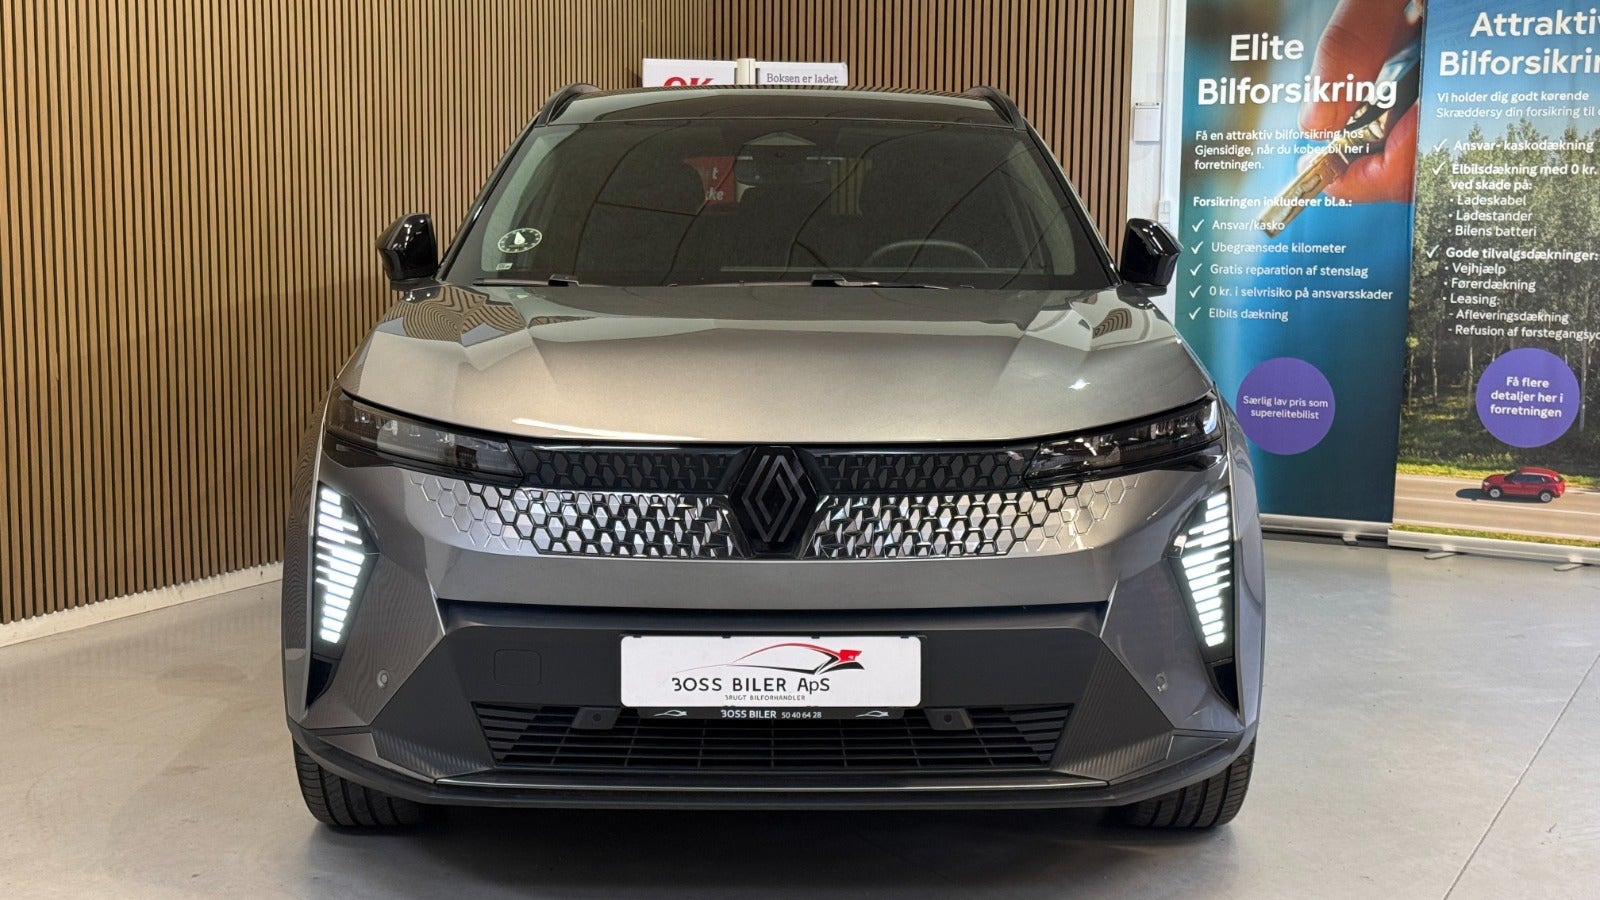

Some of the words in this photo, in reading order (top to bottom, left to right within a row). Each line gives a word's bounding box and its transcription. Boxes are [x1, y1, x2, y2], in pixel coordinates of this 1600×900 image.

[1470, 8, 1600, 37] Attrakti
[1230, 32, 1304, 61] Elite
[767, 73, 800, 84] Boksen
[802, 75, 812, 83] er
[814, 74, 838, 84] ladet
[1198, 74, 1398, 109] Bilforsikring
[1437, 92, 1449, 102] Vi
[1451, 92, 1488, 102] holder
[1490, 91, 1508, 104] dig
[1511, 91, 1538, 104] godt
[1541, 90, 1590, 101] kørende
[1436, 107, 1502, 119] Skræddersy
[1505, 106, 1522, 117] din
[1526, 106, 1580, 119] forsikring
[1583, 106, 1594, 117] til
[1196, 130, 1208, 140] Få
[1210, 132, 1223, 140] en
[1226, 130, 1272, 140] attraktiv
[1275, 129, 1342, 142] bilforsikring
[1344, 128, 1364, 139] hos
[1195, 145, 1254, 157] Gjensidige,
[1257, 144, 1275, 154] når
[1277, 144, 1291, 154] du
[1328, 143, 1341, 154] bil
[1345, 143, 1364, 154] her
[1454, 140, 1500, 150] Ansvar-
[1504, 140, 1594, 153] kaskodækning
[1195, 160, 1264, 171] forretningen.
[1452, 164, 1538, 177] Elbilsdækning
[1540, 164, 1568, 175] med
[1571, 164, 1579, 175] 0
[1582, 164, 1597, 175] kr.
[1451, 180, 1472, 190] ved
[1476, 180, 1511, 190] skade
[1514, 179, 1532, 192] på:
[1193, 196, 1260, 208] Forsikringen
[1264, 196, 1322, 207] inkluderer
[1457, 195, 1526, 206] Ladeskabel
[1456, 210, 1532, 222] Ladestander
[1212, 220, 1285, 232] Ansvar/kasko
[1455, 225, 1492, 236] Bilens
[1496, 226, 1536, 237] batteri
[1212, 242, 1288, 254] Ubegrænsede
[1292, 242, 1346, 254] kilometer
[1446, 247, 1479, 259] Gode
[1482, 248, 1598, 264] tilvalgsdækninger:
[1210, 264, 1243, 275] Gratis
[1246, 264, 1303, 277] reparation
[1306, 265, 1317, 276] af
[1320, 266, 1368, 279] stenslag
[1452, 262, 1506, 275] Vejhjælp
[1451, 278, 1536, 293] Førerdækning
[1210, 286, 1216, 296] 0
[1219, 286, 1232, 296] kr.
[1241, 286, 1292, 298] selvrisiko
[1294, 287, 1309, 300] på
[1312, 288, 1393, 300] ansvarsskader
[1450, 293, 1500, 306] Leasing:
[1209, 308, 1238, 319] Elbils
[1241, 308, 1288, 322] dækning
[1456, 310, 1569, 325] Afleveringsdækning
[1455, 326, 1504, 336] Refusion
[1507, 326, 1518, 337] af
[1506, 376, 1519, 387] Få
[1522, 377, 1550, 388] flere
[1243, 396, 1272, 406] Særlig
[1274, 397, 1288, 406] lav
[1289, 398, 1306, 408] pris
[1309, 400, 1328, 408] som
[1490, 390, 1536, 403] detaljer
[1538, 392, 1557, 403] her
[1251, 409, 1320, 420] superelitebilist
[1490, 404, 1562, 419] forretningen
[732, 678, 786, 692] BILER
[797, 678, 830, 694] ApS
[749, 710, 777, 719] BILER
